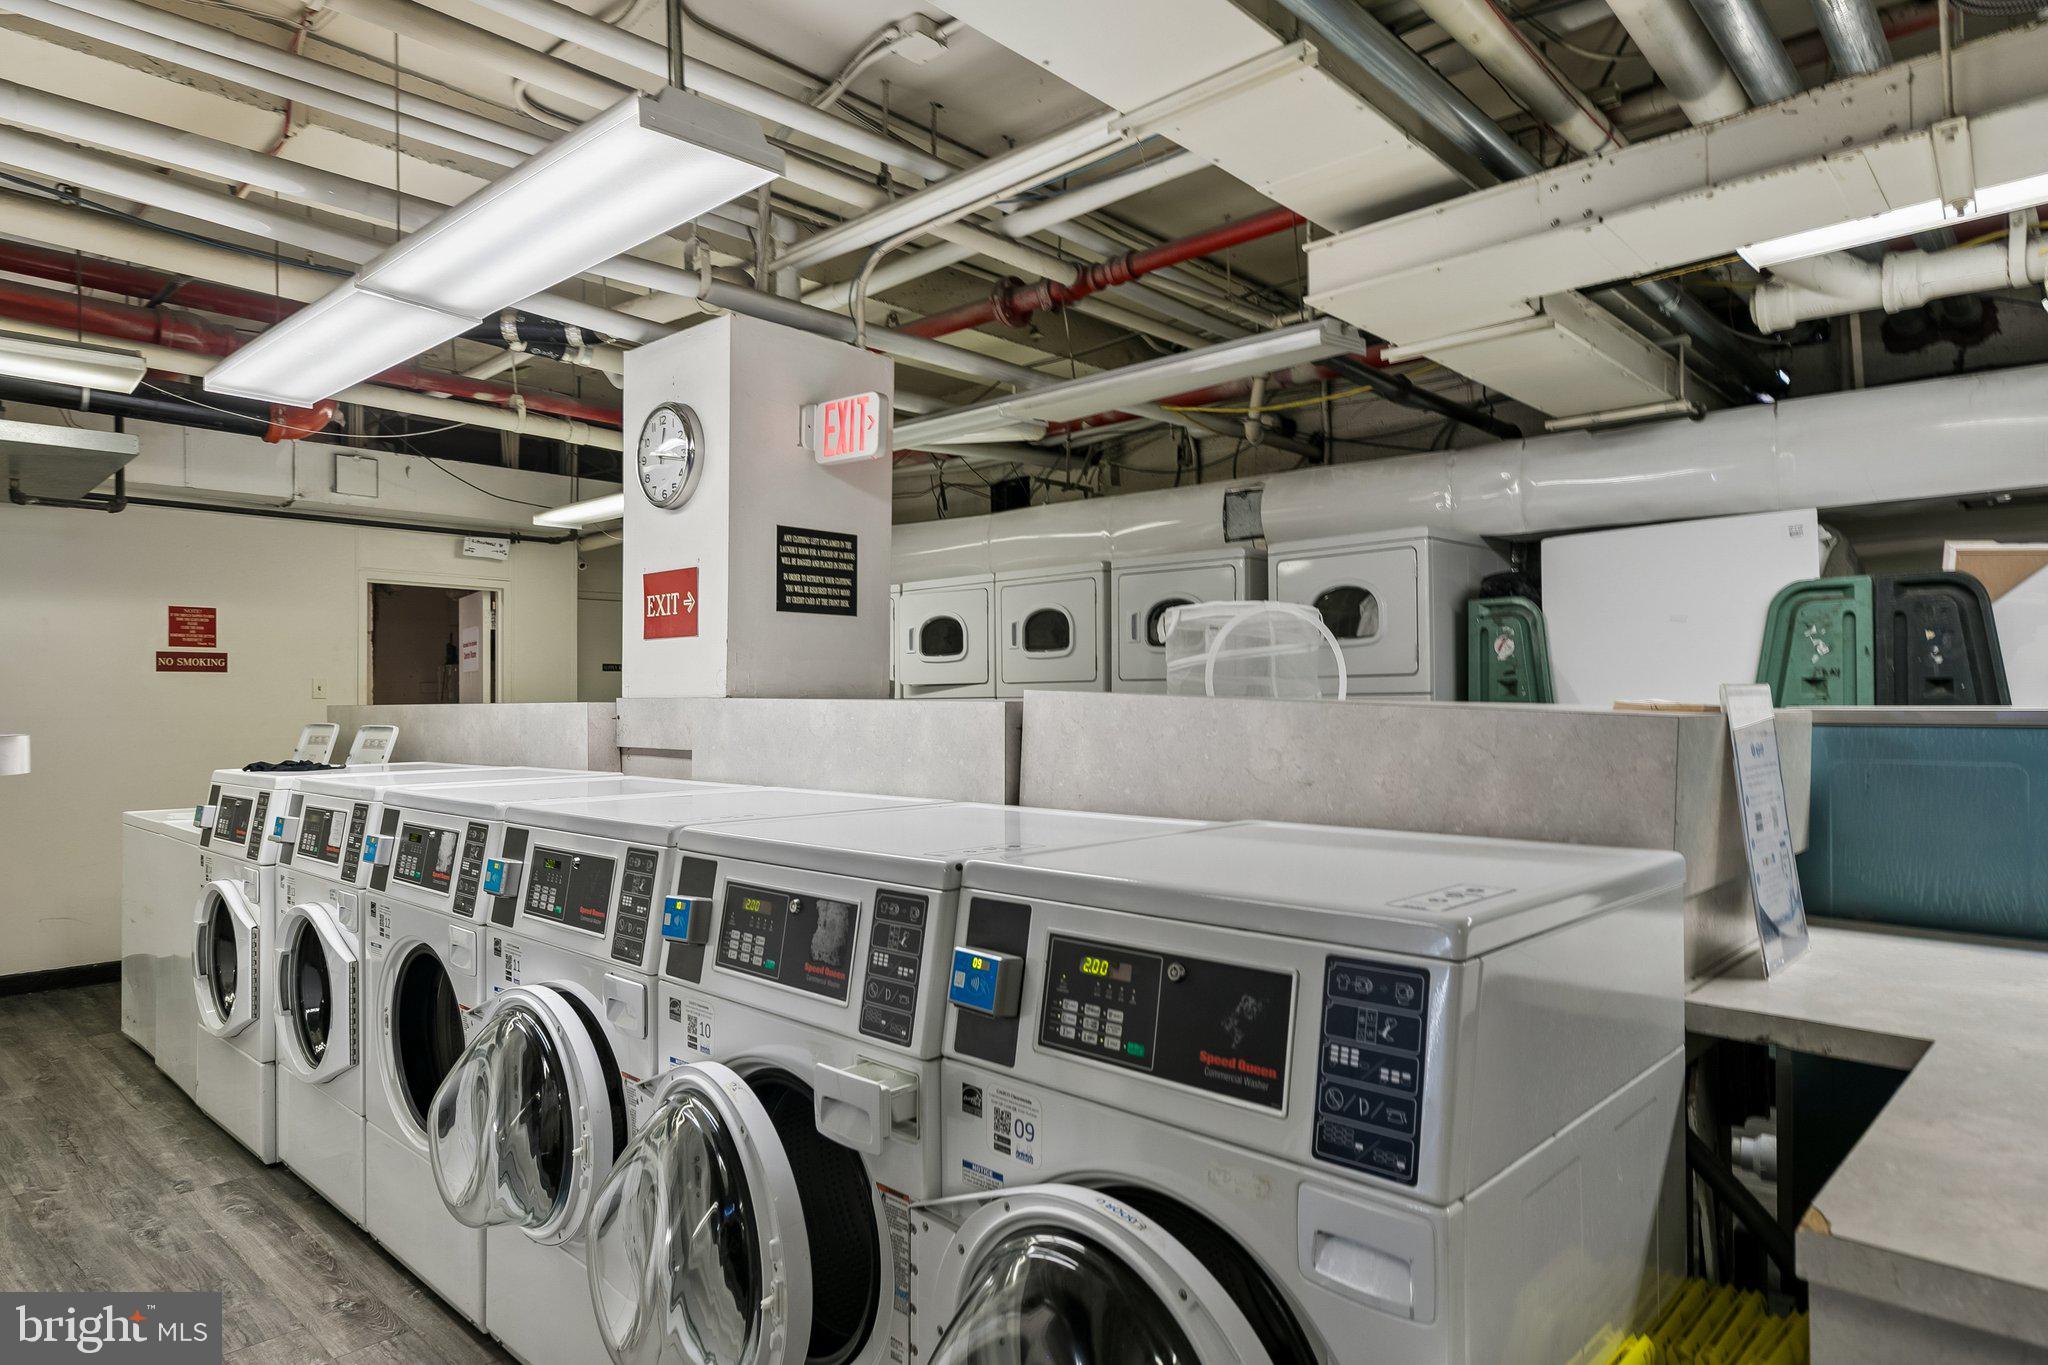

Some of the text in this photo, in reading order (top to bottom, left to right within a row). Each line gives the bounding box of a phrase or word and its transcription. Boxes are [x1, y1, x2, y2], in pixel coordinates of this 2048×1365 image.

[660, 416, 666, 425] 12
[824, 396, 869, 457] EXIT
[678, 430, 683, 439] 2
[645, 438, 650, 448] 10
[681, 449, 686, 458] 3
[642, 456, 647, 465] 9
[679, 468, 683, 476] 4
[645, 474, 650, 483] 8
[652, 486, 657, 495] 7
[672, 483, 676, 493] 5
[662, 490, 667, 499] 6
[780, 544, 798, 554] LAUNDRY
[799, 547, 810, 555] ROOM
[781, 556, 791, 565] WILL
[797, 558, 812, 567] BAGGED
[820, 560, 834, 569] PLACED
[789, 573, 801, 581] ORDER
[807, 575, 824, 584] RETRIEVE
[646, 592, 679, 617] EXIT
[792, 596, 805, 604] CREDIT
[805, 597, 815, 605] CARD
[840, 600, 850, 608] DESK
[177, 658, 225, 666] SMOKING
[972, 957, 983, 970] 09
[1082, 957, 1109, 976] 2.00
[804, 962, 845, 980] Speed Queen
[700, 1021, 711, 1038] 10
[1200, 1050, 1277, 1079] Speed Queen
[1204, 1067, 1269, 1092] Commercial Washer
[1014, 1118, 1035, 1142] 09
